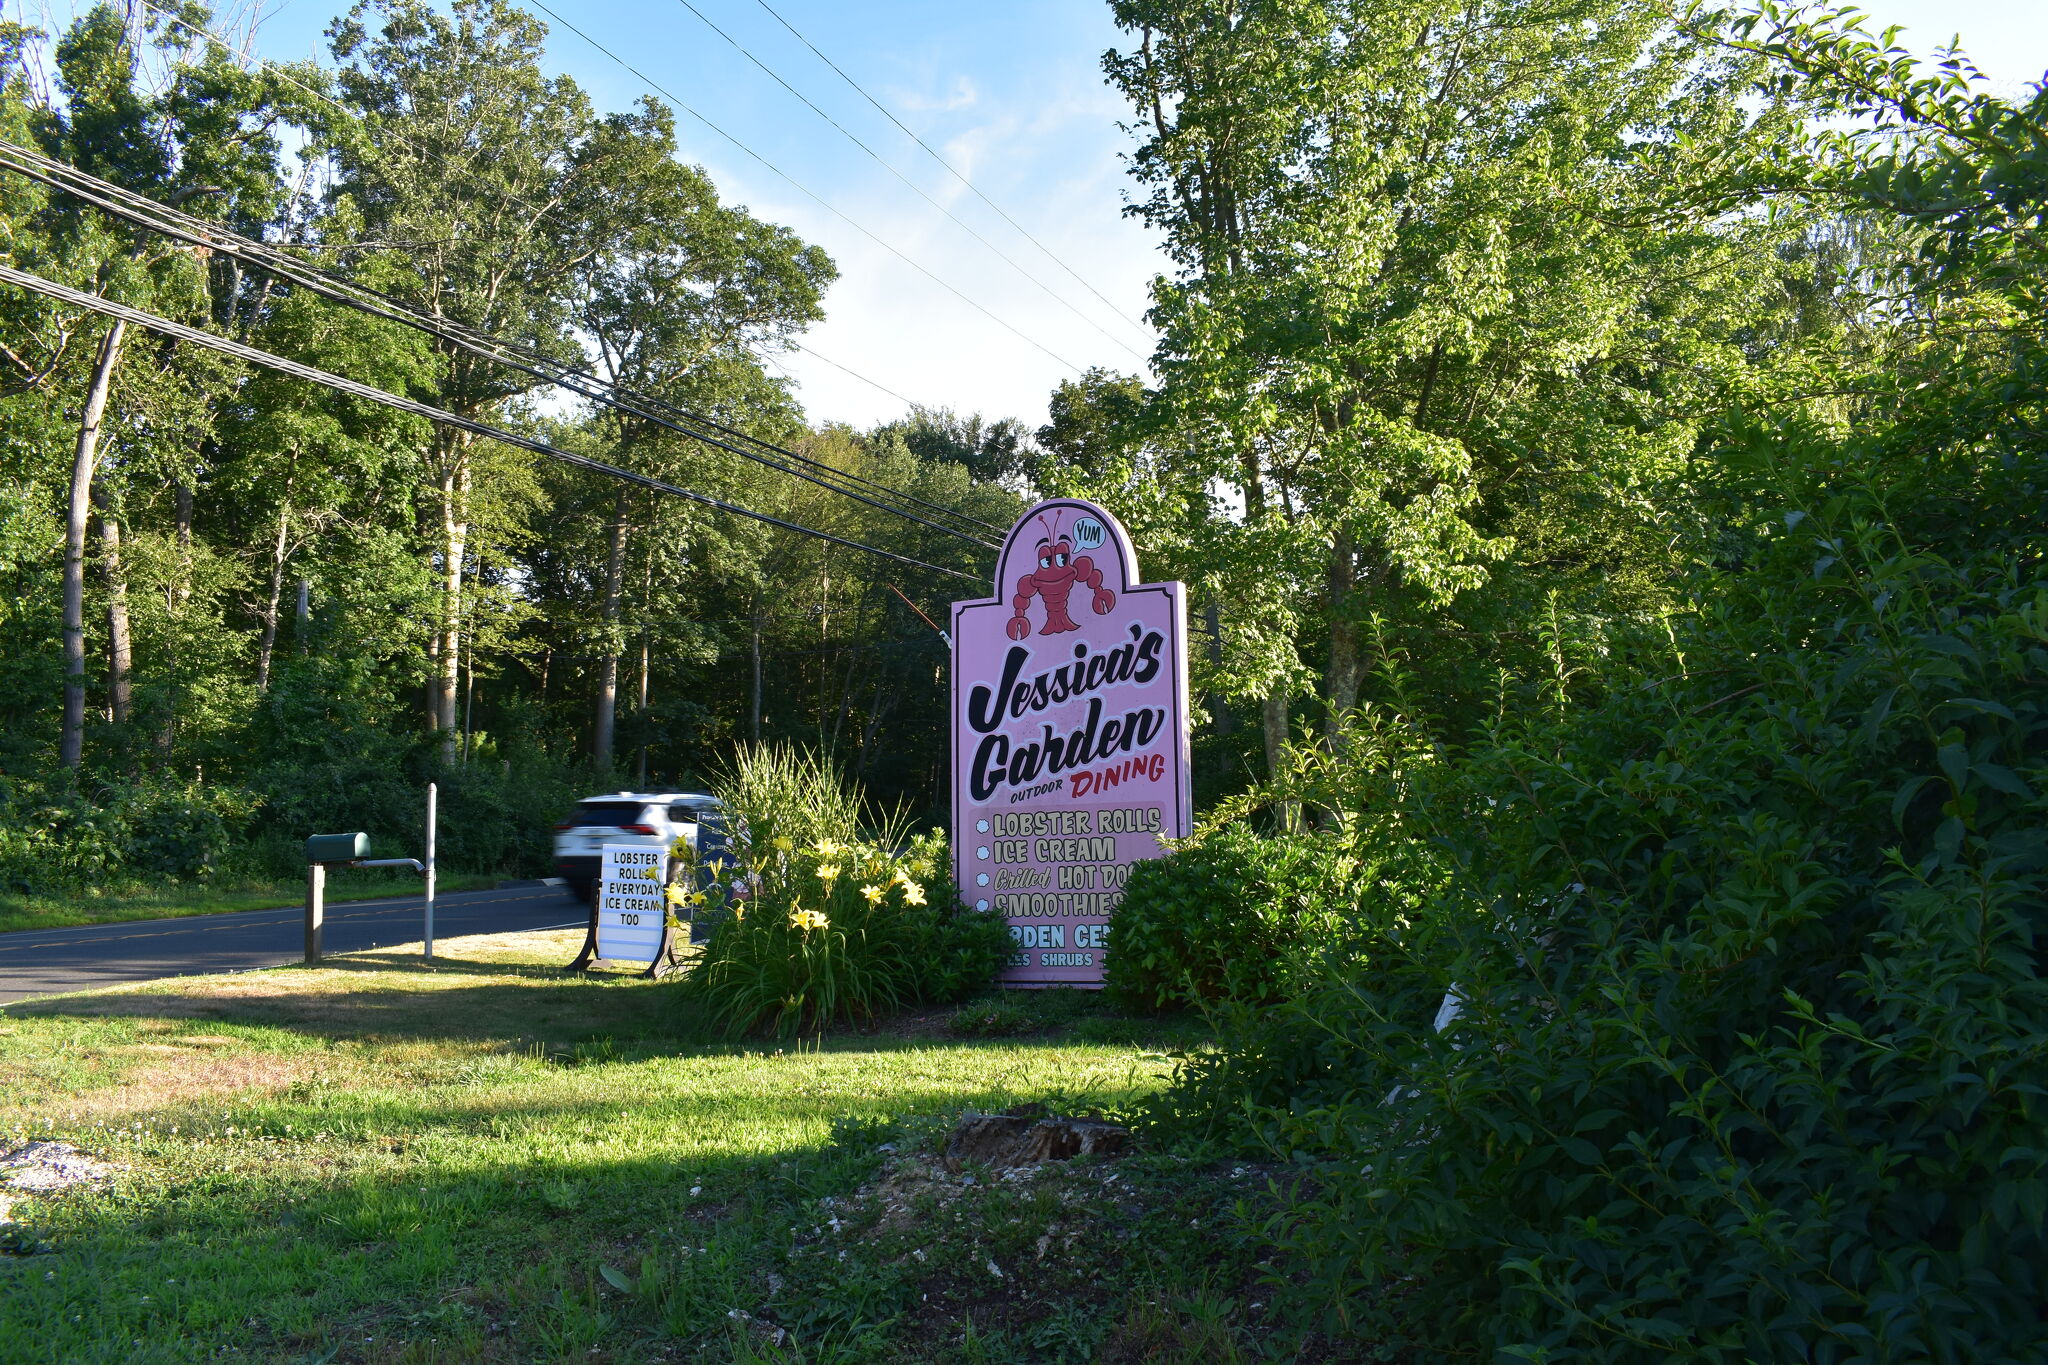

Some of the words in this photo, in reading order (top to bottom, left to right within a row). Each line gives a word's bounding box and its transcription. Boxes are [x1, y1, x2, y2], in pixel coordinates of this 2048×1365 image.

[1076, 520, 1101, 544] YUM
[968, 624, 1164, 733] Jessica's
[970, 698, 1165, 801] Garden
[1010, 779, 1063, 804] OUTDOOR
[1070, 753, 1165, 799] DINING
[993, 811, 1092, 837] LOBSTER
[1098, 808, 1161, 834] ROLLS
[614, 852, 658, 864] LOBSTER
[993, 839, 1028, 864] ICE
[1034, 836, 1115, 863] CREAM
[609, 882, 660, 896] EVERYDAY
[994, 865, 1051, 891] Grilled
[1058, 865, 1097, 890] HOT
[605, 897, 620, 910] ICE
[624, 898, 660, 911] CREAM
[620, 913, 639, 926] TOO
[1041, 952, 1094, 967] SHRUBS
